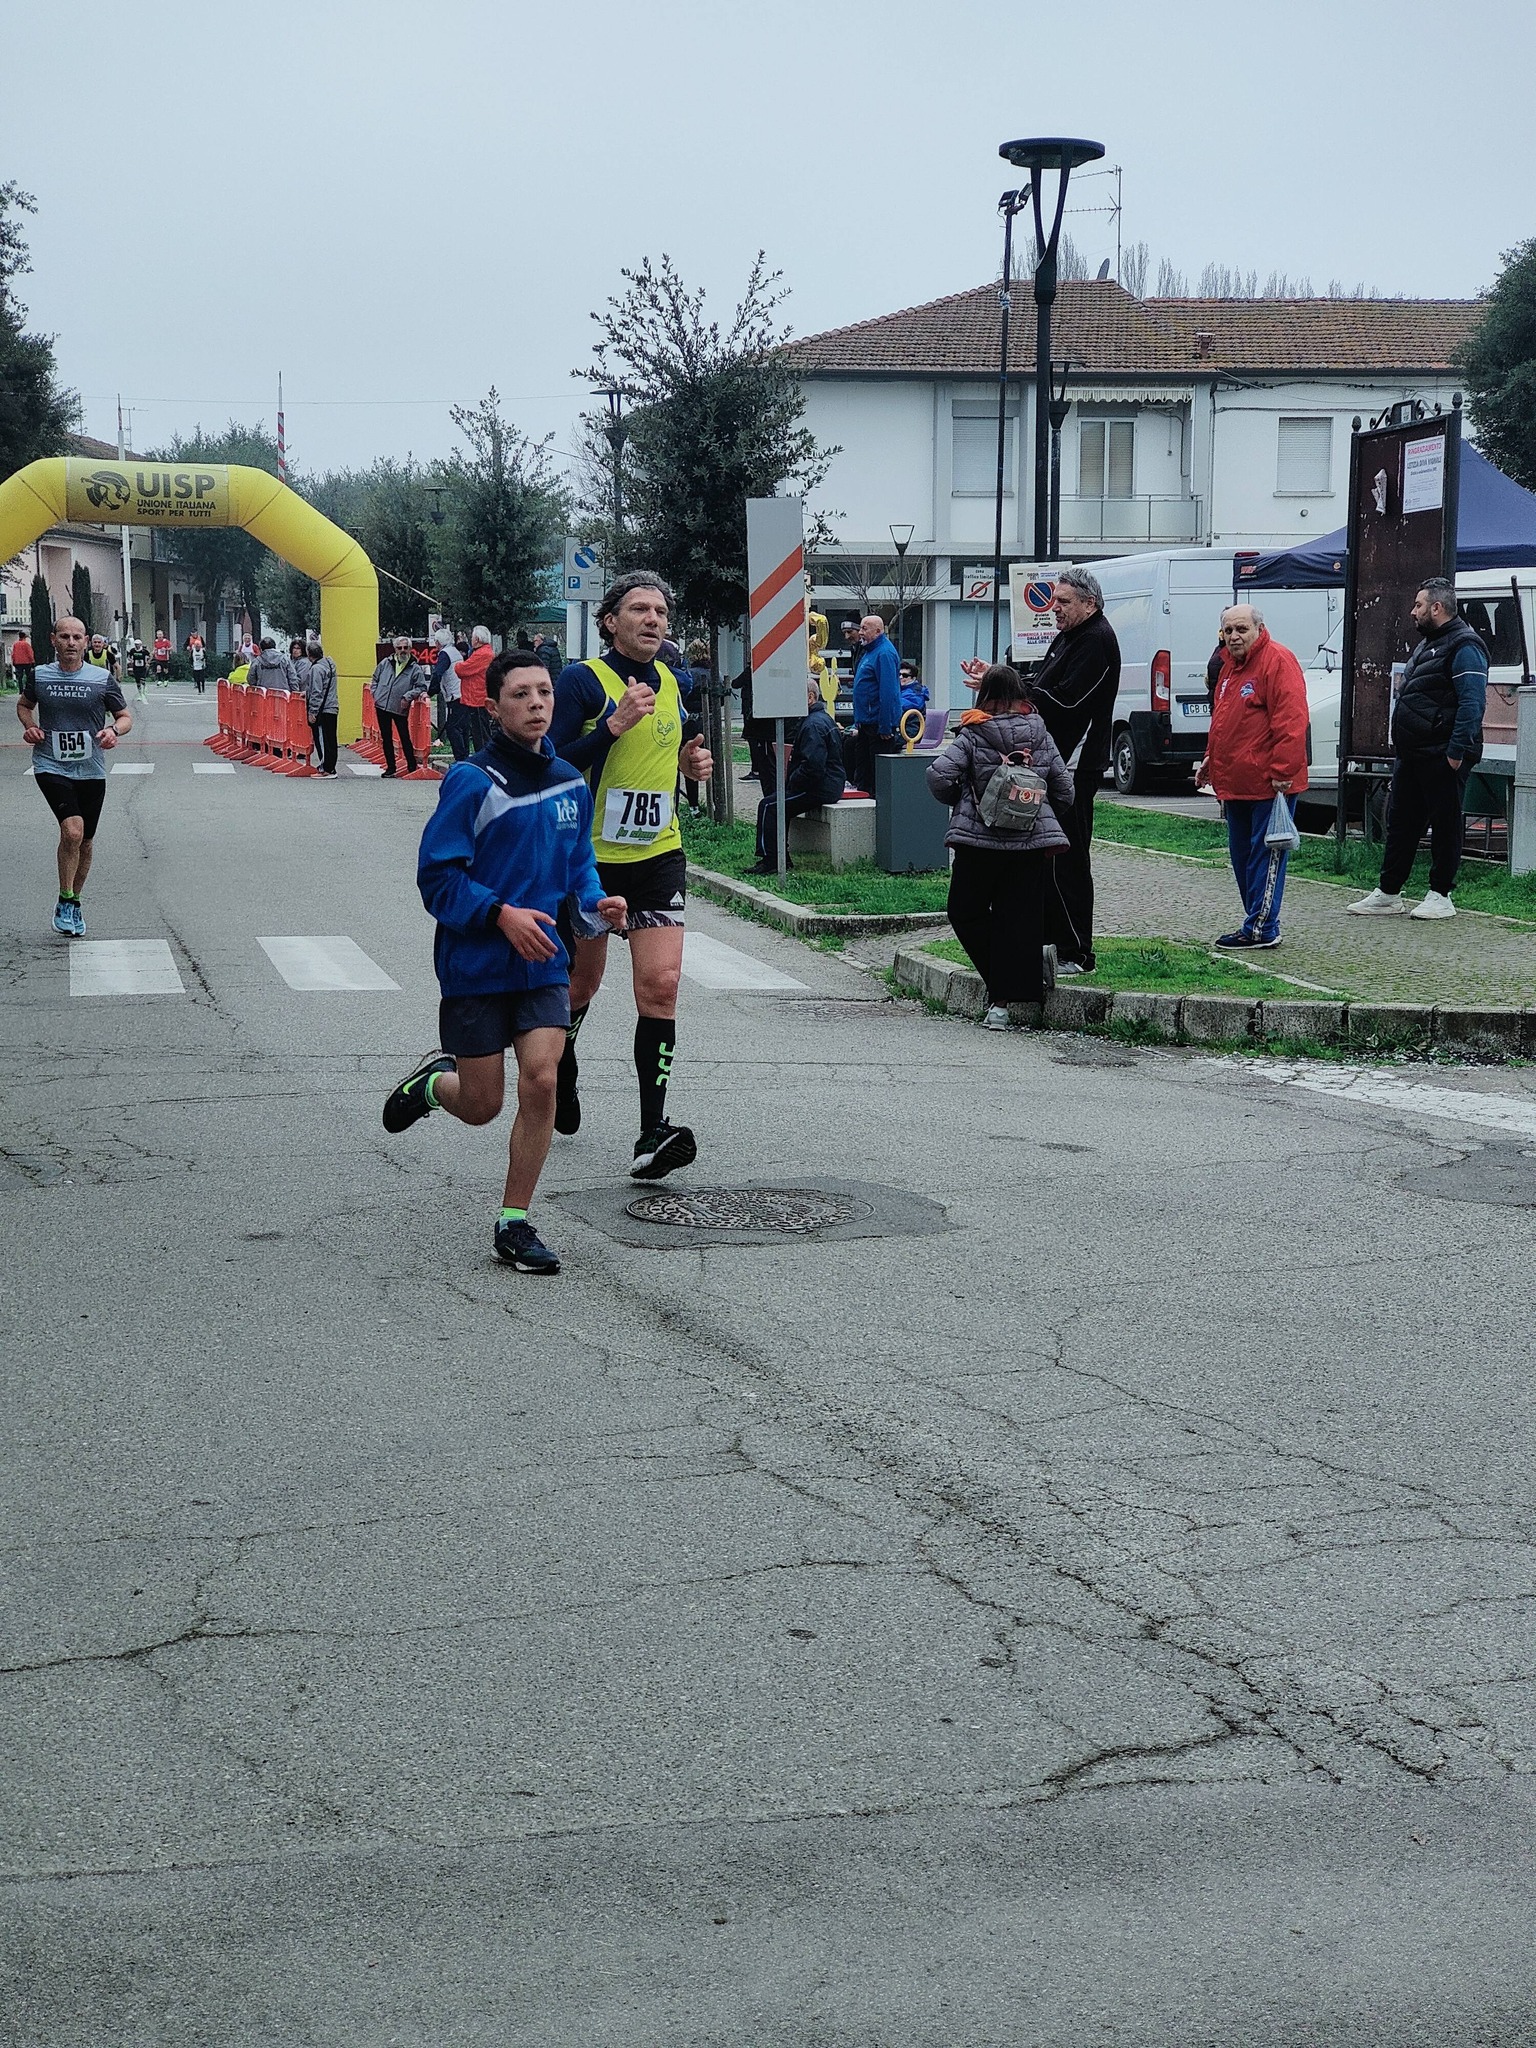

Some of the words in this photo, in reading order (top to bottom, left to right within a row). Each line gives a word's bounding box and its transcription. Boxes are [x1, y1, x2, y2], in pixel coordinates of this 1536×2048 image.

[136, 472, 216, 499] UISP
[137, 499, 172, 509] UNIONE
[176, 500, 216, 510] ITALIANA
[137, 509, 165, 517] SPORT
[189, 510, 211, 518] TUTTI
[570, 577, 578, 588] P
[1189, 704, 1200, 713] GB
[59, 733, 85, 751] 654
[620, 791, 662, 827] 785
